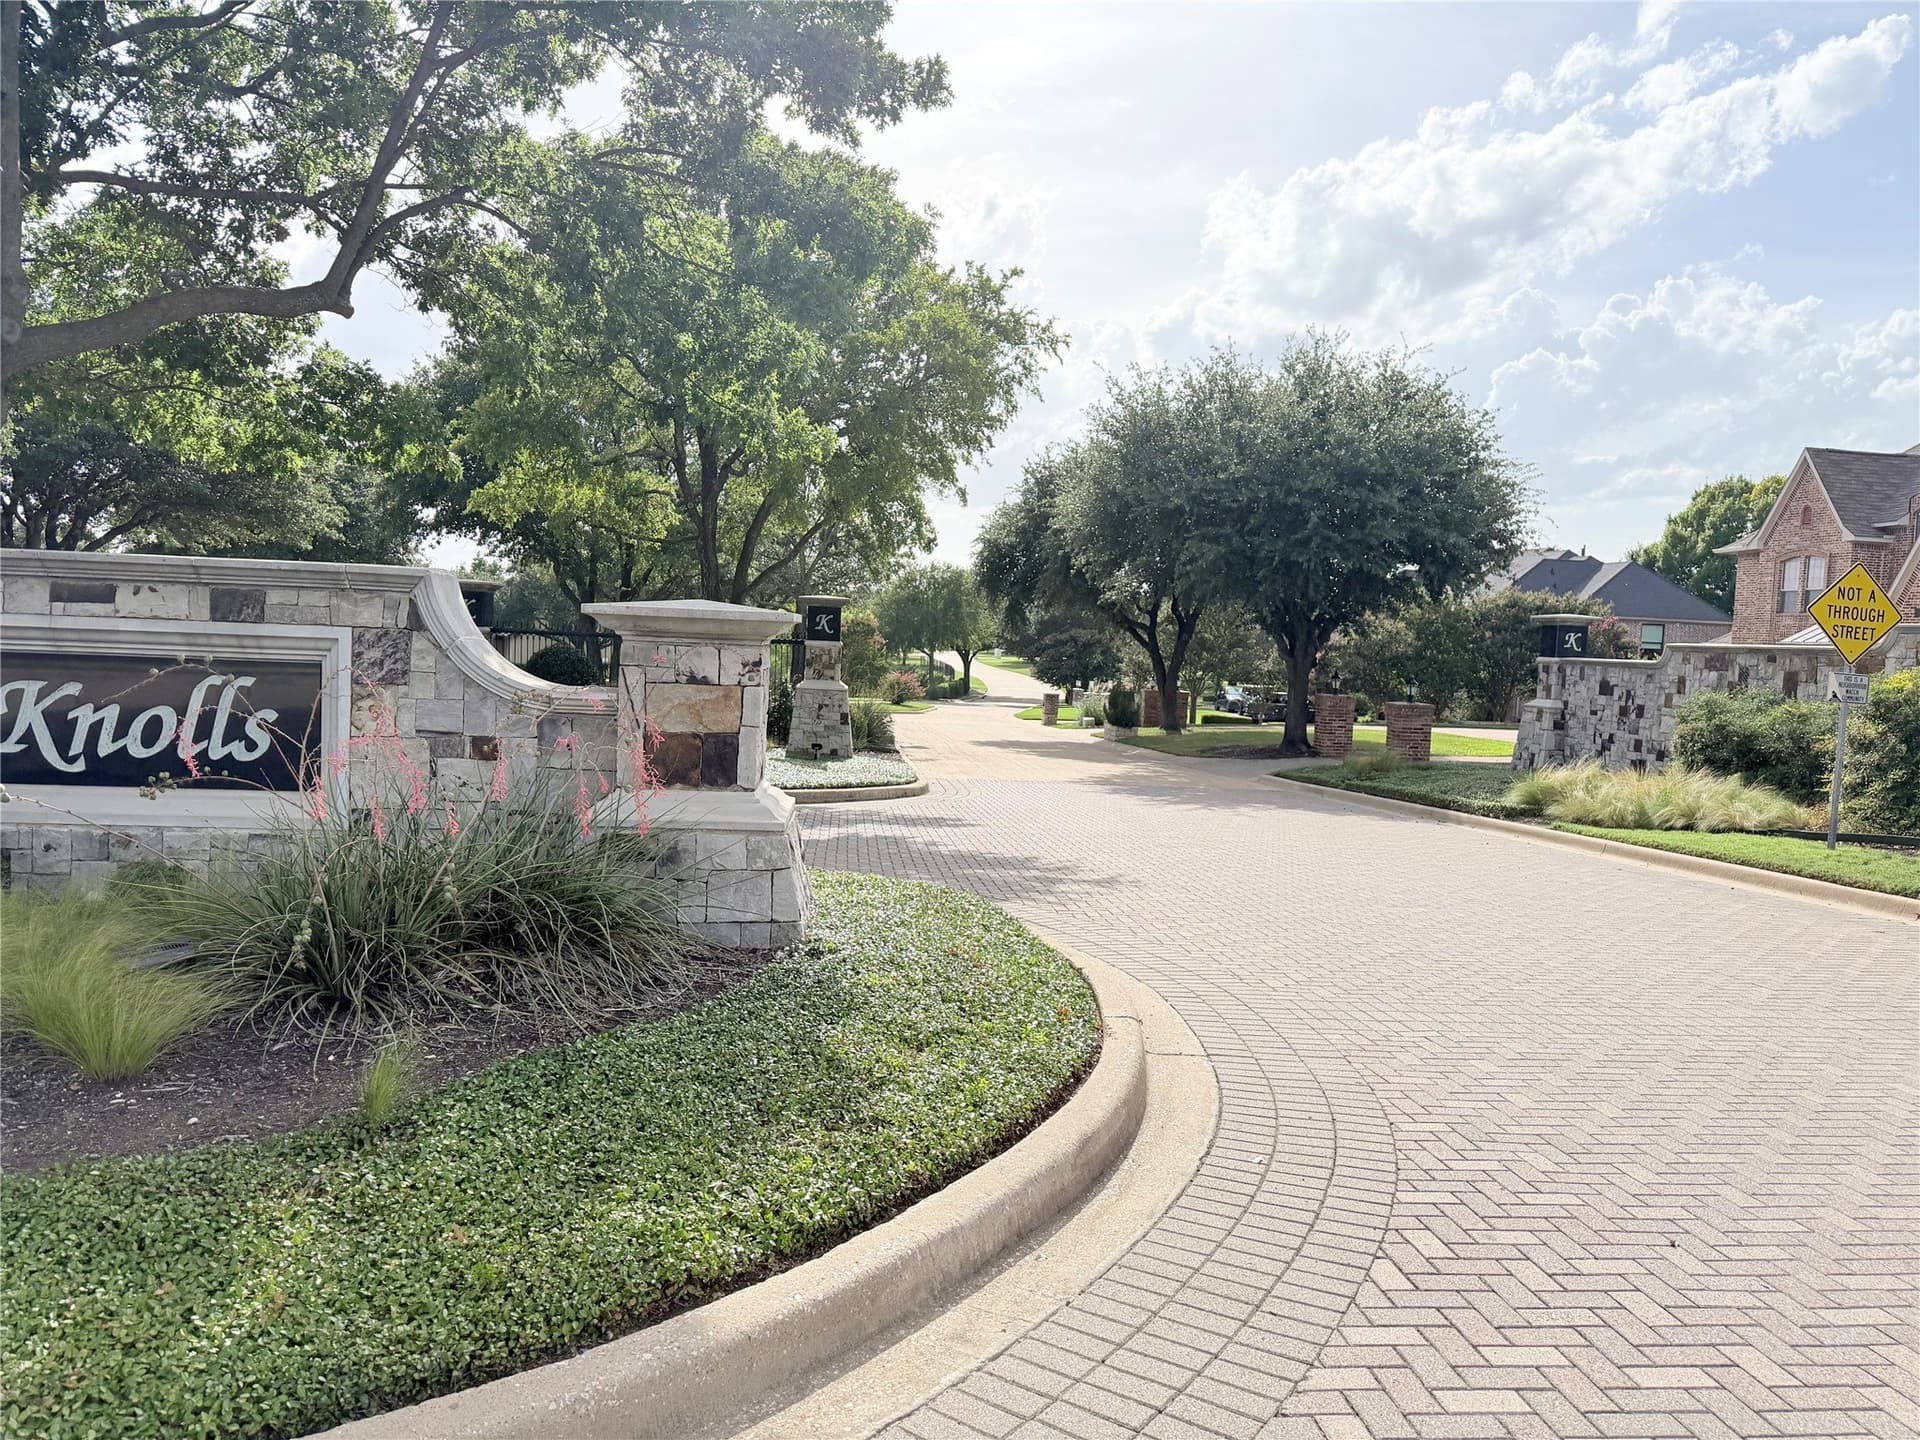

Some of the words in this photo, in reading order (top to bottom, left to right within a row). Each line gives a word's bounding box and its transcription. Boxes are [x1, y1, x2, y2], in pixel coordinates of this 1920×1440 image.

[1837, 586, 1862, 601] NOT
[1868, 589, 1876, 603] A
[1827, 604, 1885, 623] THROUGH
[814, 614, 834, 634] K
[1831, 624, 1876, 641] STREET
[1563, 632, 1582, 652] K
[0, 674, 279, 773] Knolls
